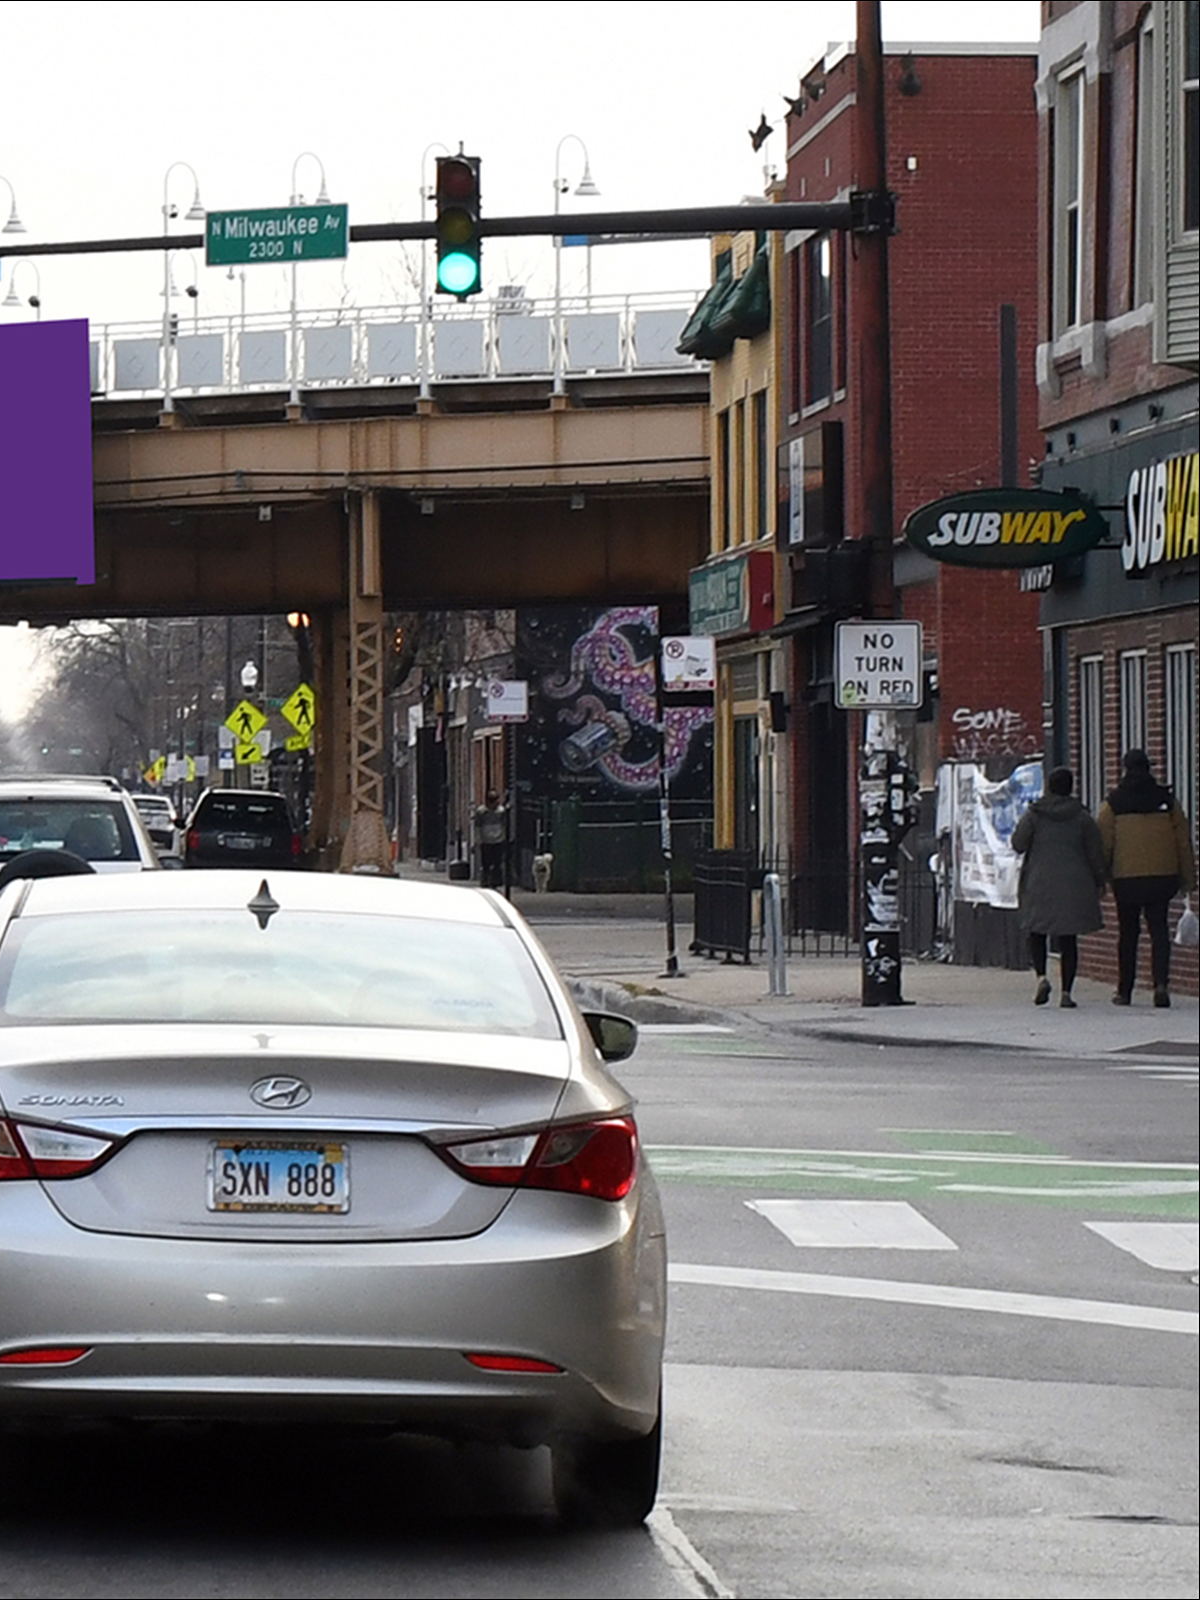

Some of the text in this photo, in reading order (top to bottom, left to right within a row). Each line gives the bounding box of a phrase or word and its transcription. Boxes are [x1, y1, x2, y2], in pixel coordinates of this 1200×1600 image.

[212, 214, 340, 239] N Milwaukee Av
[249, 241, 303, 258] 2300 N
[927, 510, 1086, 546] SUBWAY
[863, 633, 894, 649] NO
[855, 656, 904, 672] TURN
[842, 680, 914, 695] ON RED
[952, 708, 1022, 732] SOME
[18, 1095, 125, 1107] SONATA
[222, 1161, 335, 1197] SXN 888
